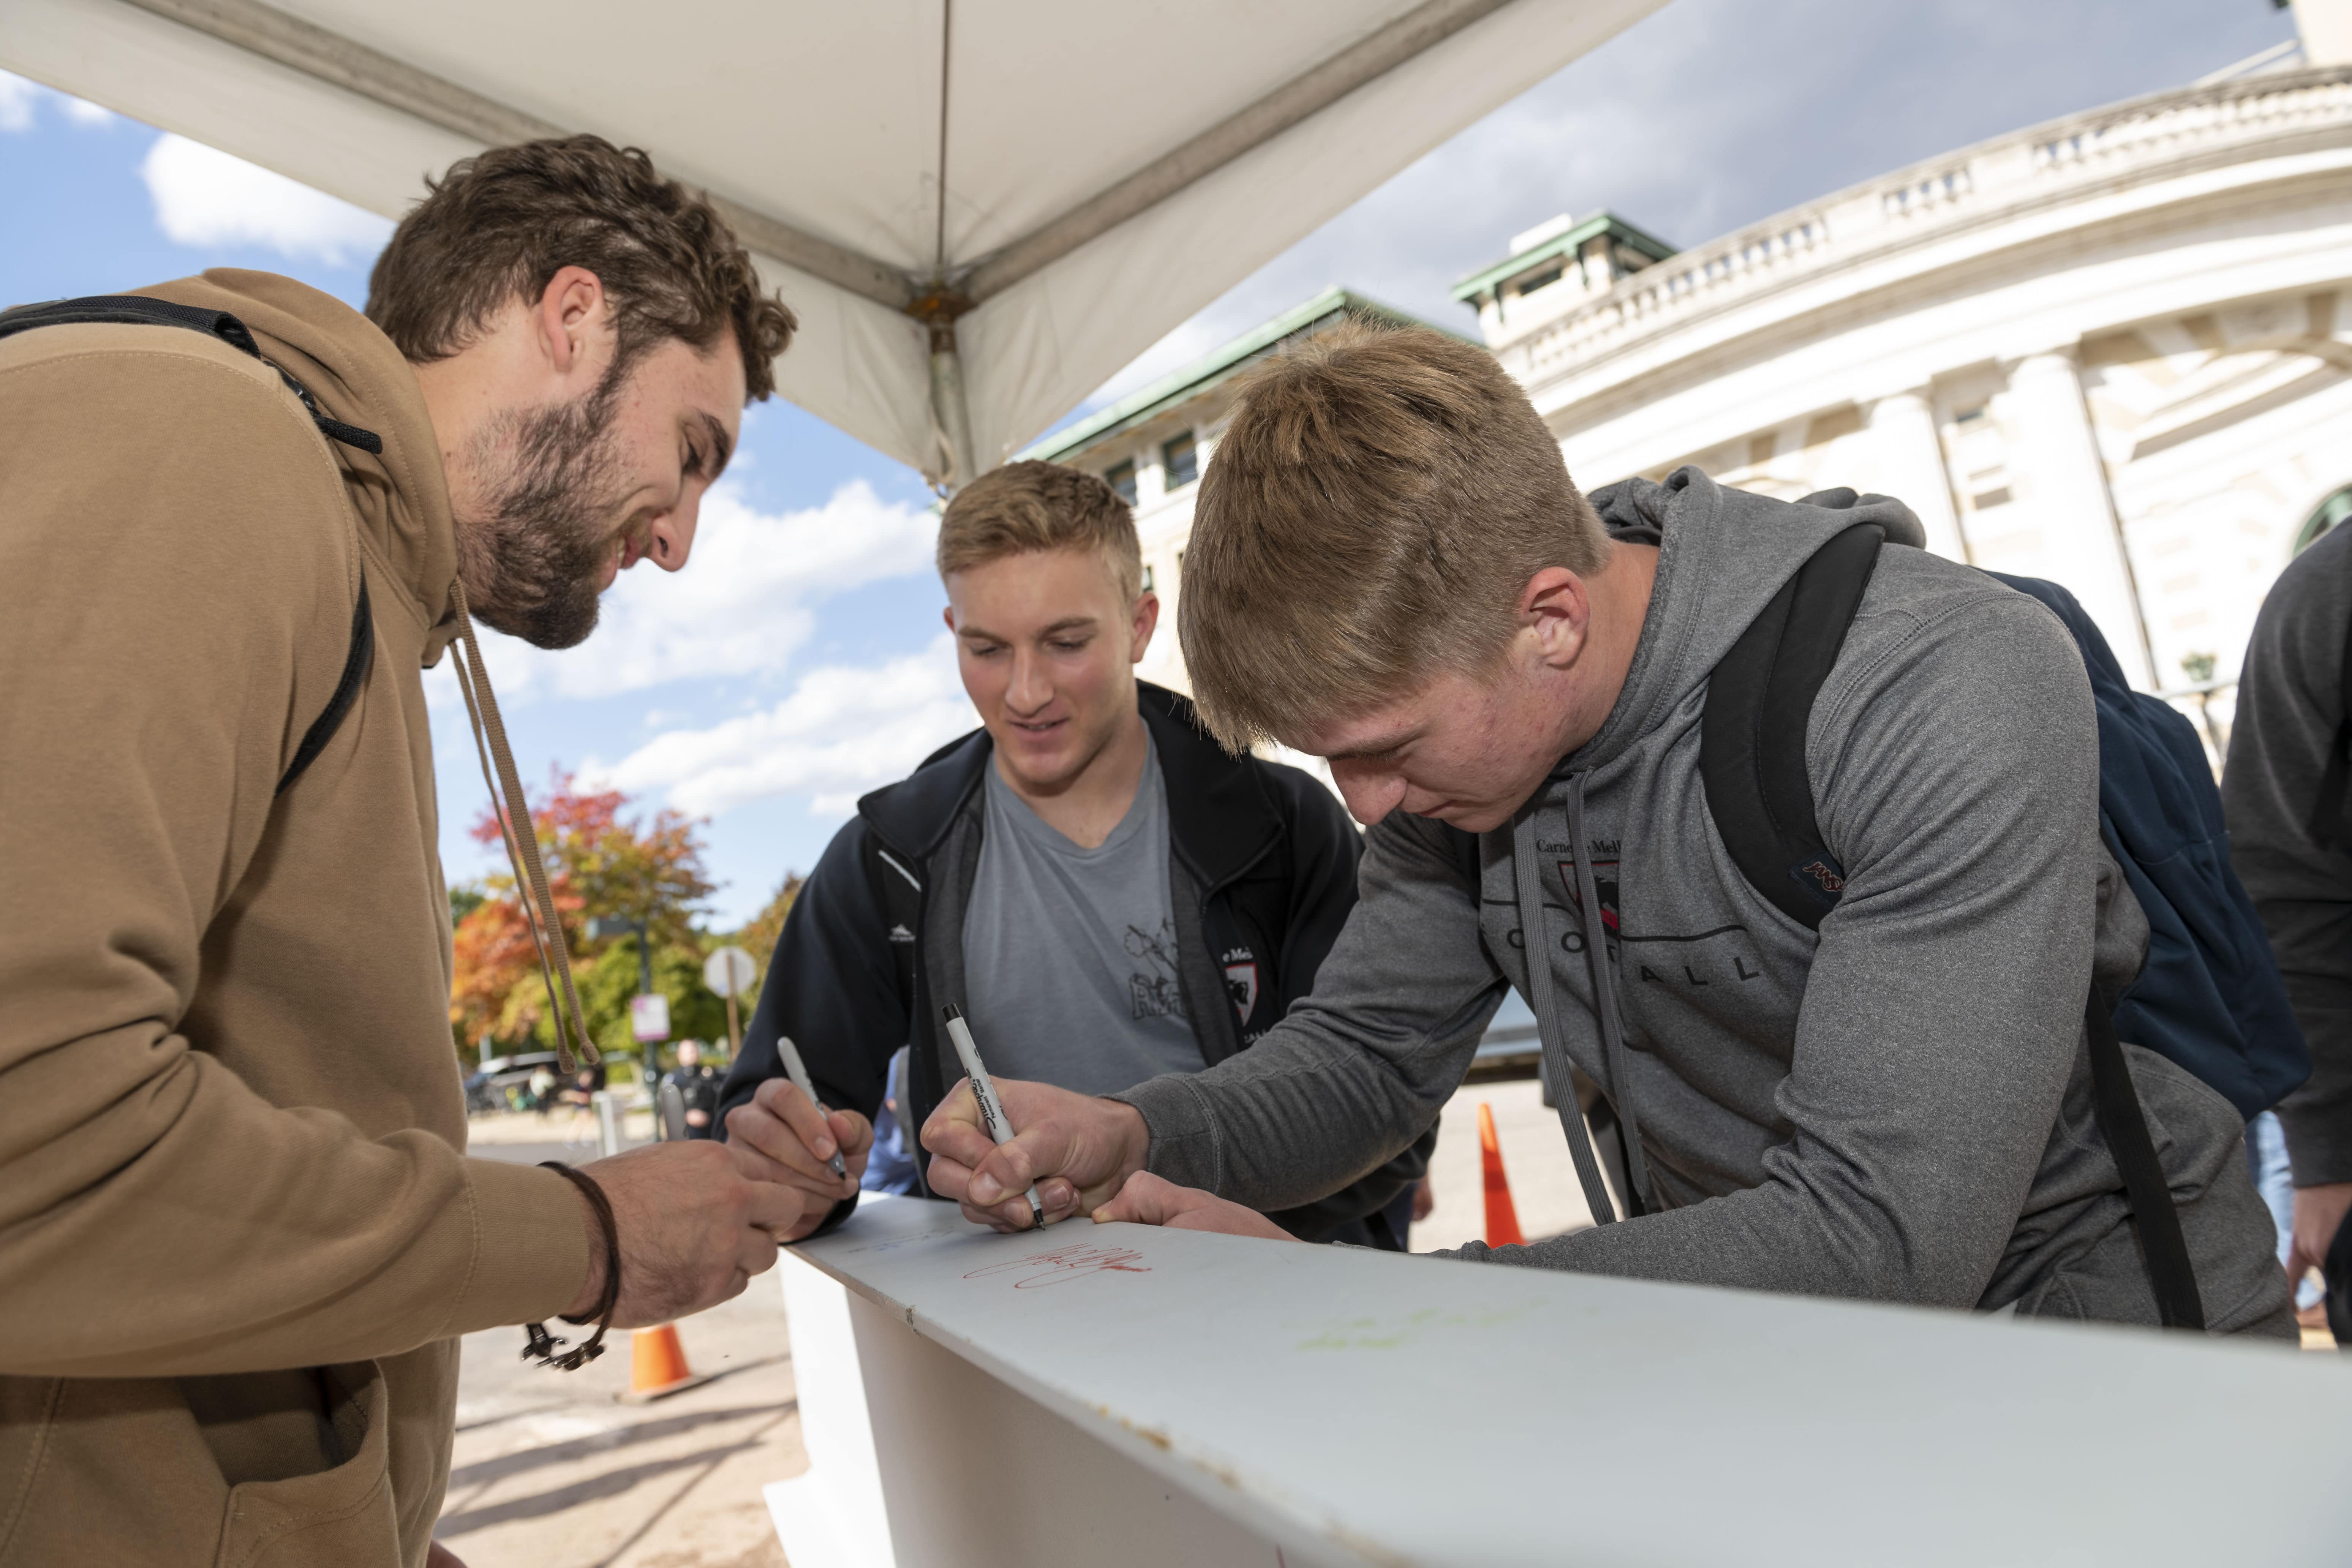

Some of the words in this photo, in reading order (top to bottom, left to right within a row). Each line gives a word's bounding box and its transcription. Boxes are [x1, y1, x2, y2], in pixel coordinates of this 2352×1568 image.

[1537, 839, 1590, 853] Carne
[1592, 840, 1621, 853] Mell
[1803, 861, 1845, 892] JANS
[1482, 923, 1760, 985] OOTALL
[976, 1079, 985, 1094] Marker
[983, 1095, 996, 1119] Permanent
